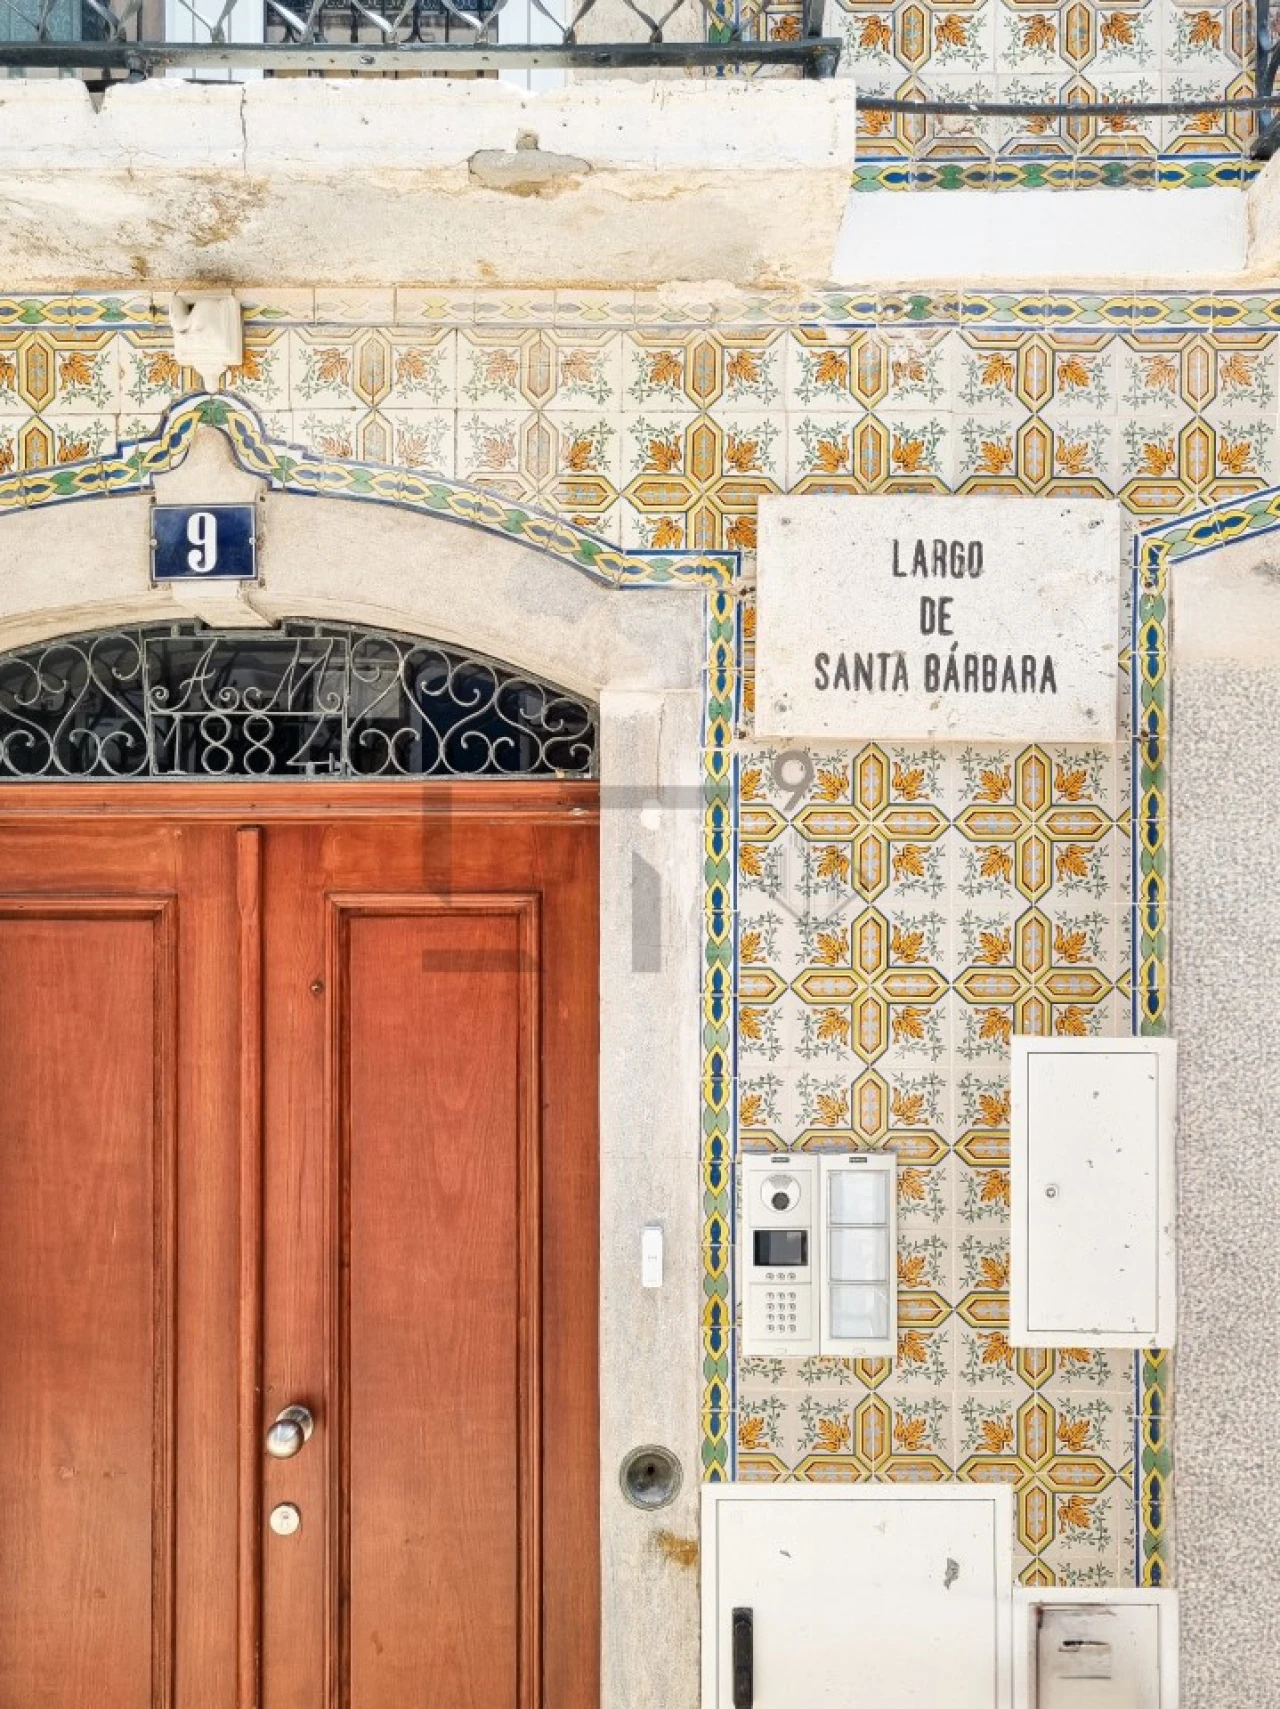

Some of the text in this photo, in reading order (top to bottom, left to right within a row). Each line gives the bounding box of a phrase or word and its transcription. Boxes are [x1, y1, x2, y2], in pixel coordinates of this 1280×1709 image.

[187, 512, 217, 573] 9
[892, 539, 984, 579] LARGO
[919, 596, 954, 636] DE
[814, 640, 1057, 694] SANTA BÁRBARA
[163, 713, 345, 776] 1884
